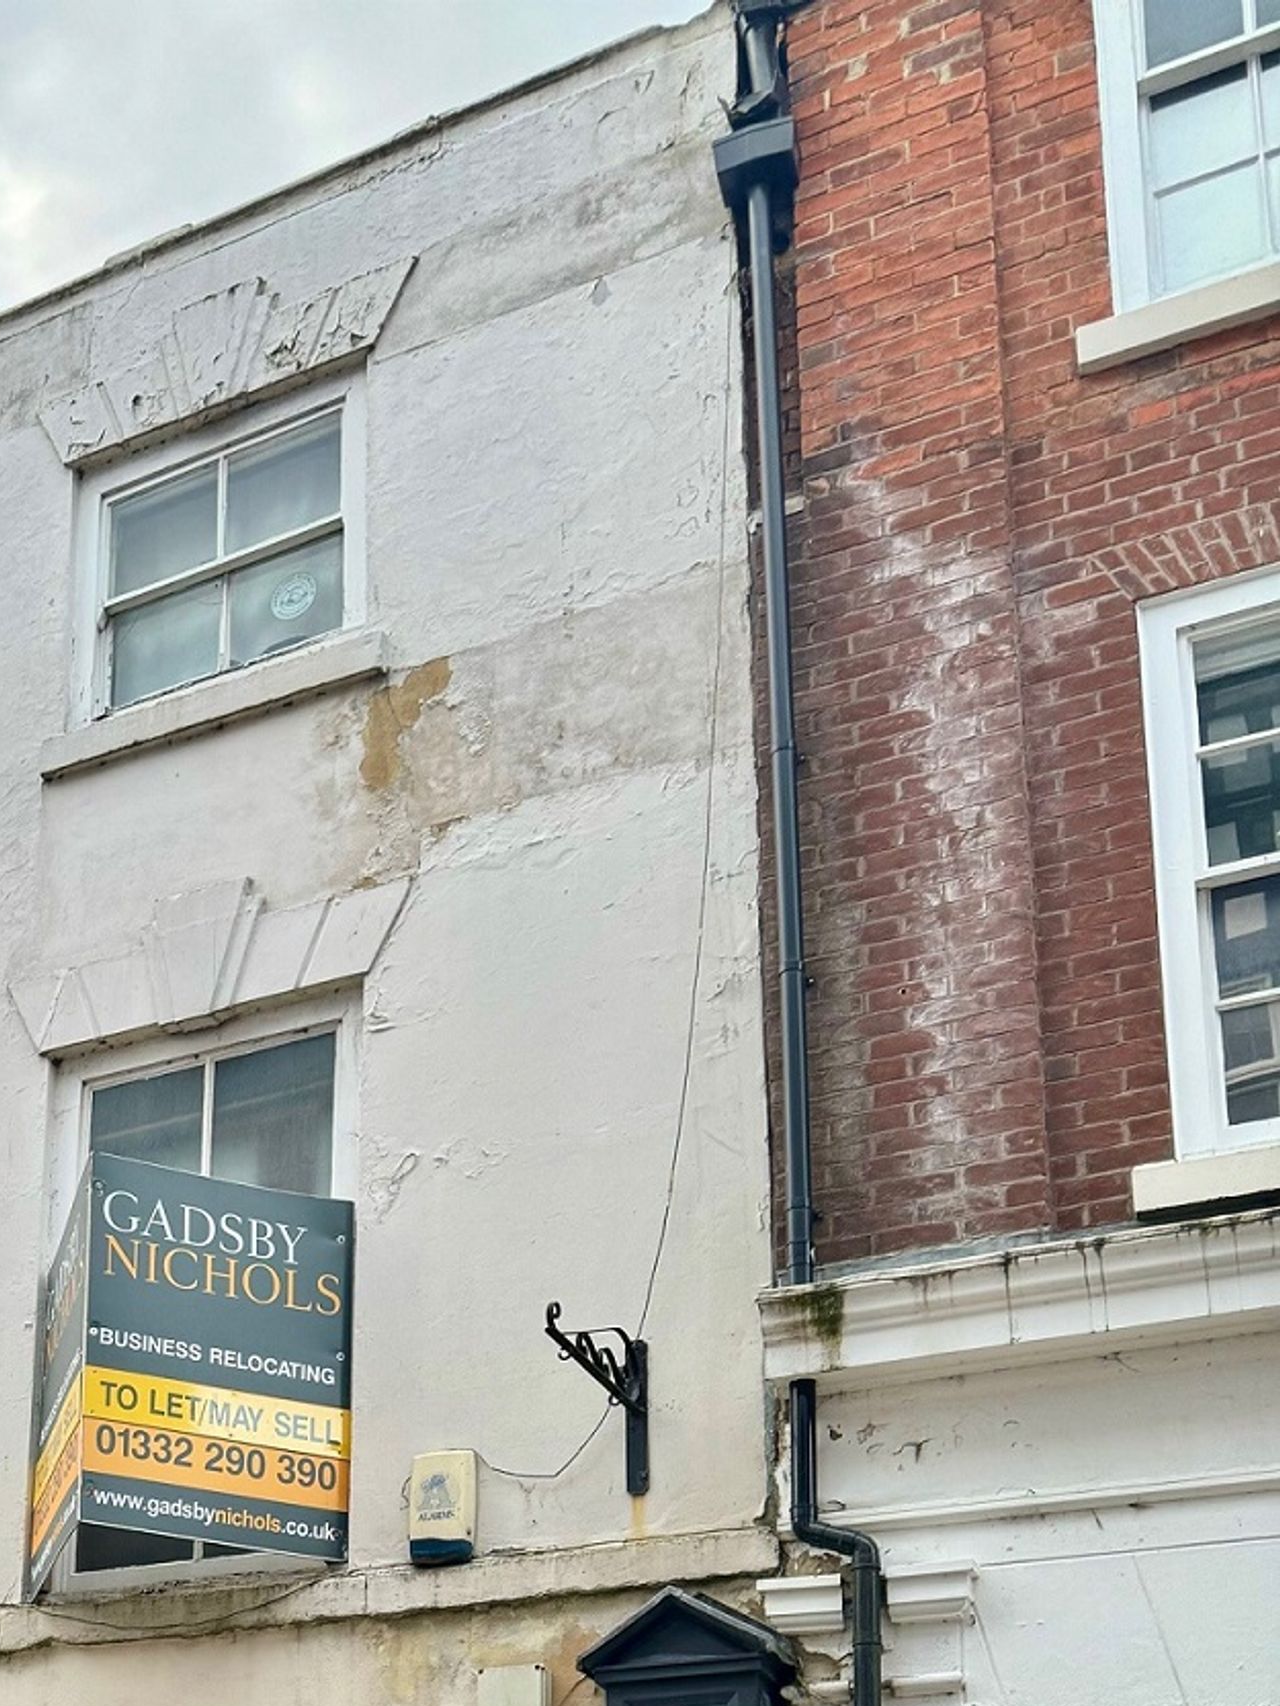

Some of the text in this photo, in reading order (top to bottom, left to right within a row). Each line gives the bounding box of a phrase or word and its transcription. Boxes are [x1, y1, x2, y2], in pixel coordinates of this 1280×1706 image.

[103, 1190, 308, 1265] GADSBY
[104, 1234, 342, 1316] NICHOLS
[100, 1327, 335, 1385] BUSINESS RELOCATING
[100, 1380, 342, 1446] TO LET/MAY SELL
[96, 1424, 337, 1490] 01332 290 390
[94, 1488, 336, 1542] www.gadsbynichols.co.uk
